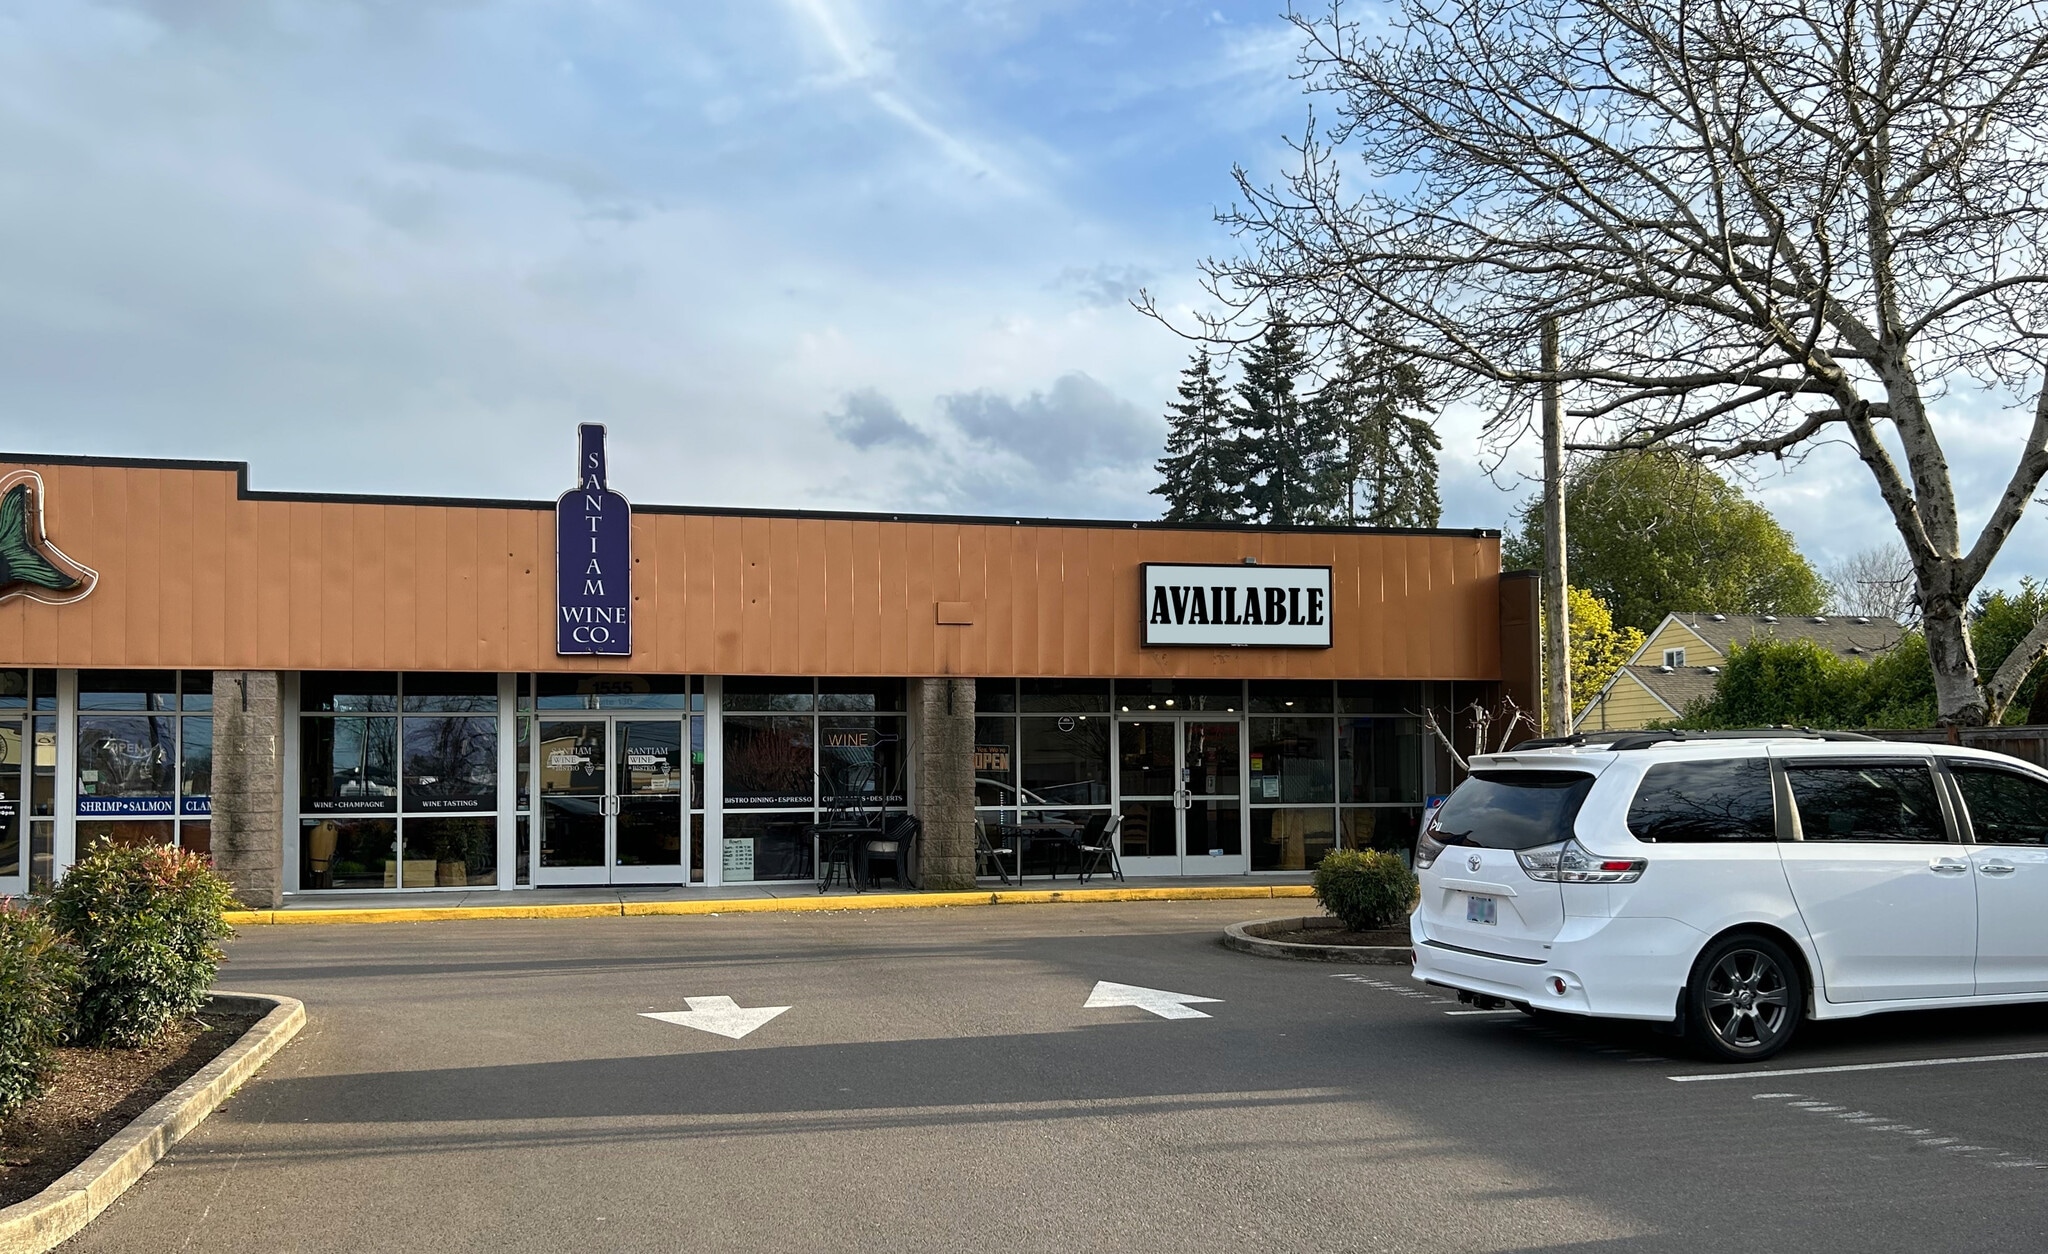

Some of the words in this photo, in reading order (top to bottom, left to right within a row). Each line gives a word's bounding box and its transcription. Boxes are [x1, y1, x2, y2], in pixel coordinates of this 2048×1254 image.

[583, 452, 605, 596] SANTIAM
[1150, 586, 1324, 626] AVAILABLE
[562, 606, 627, 624] WINE
[572, 626, 616, 644] CO.
[828, 733, 868, 746] WINE
[551, 747, 592, 755] SANTIAM
[628, 747, 668, 755] SANTIAM
[974, 753, 1008, 770] OPEN
[80, 801, 122, 812] SHRIMP
[129, 801, 172, 811] SALMON
